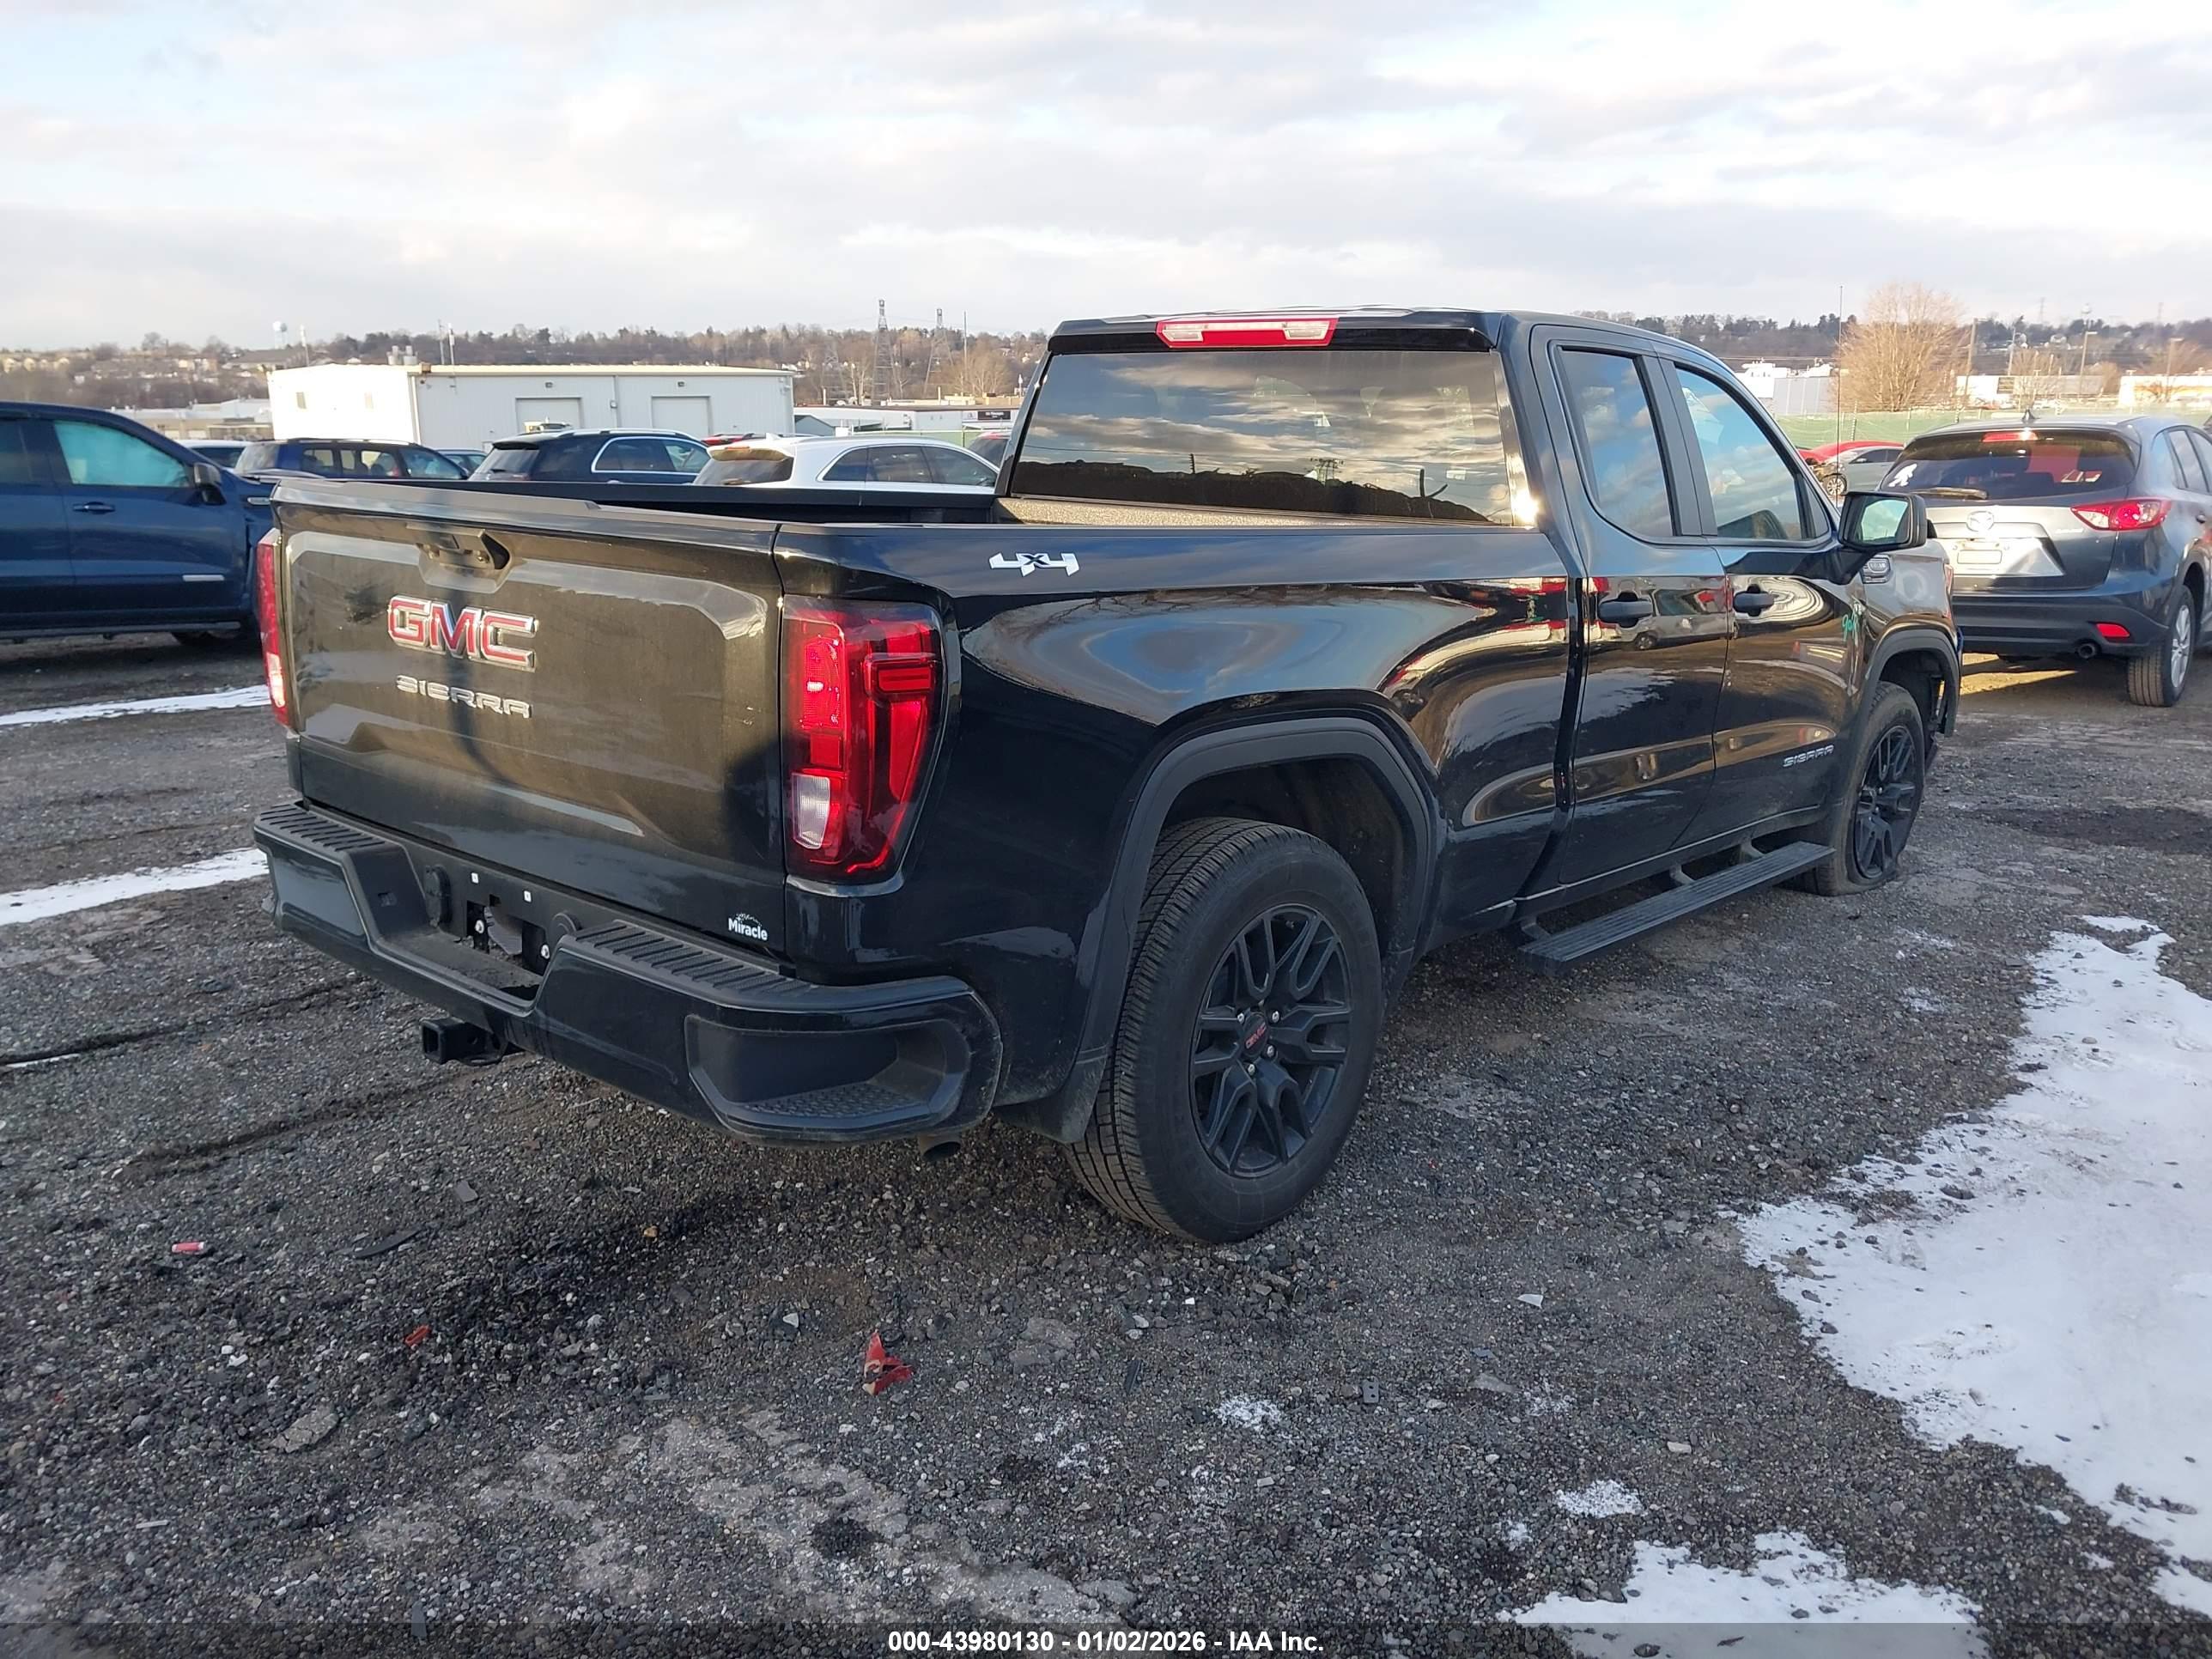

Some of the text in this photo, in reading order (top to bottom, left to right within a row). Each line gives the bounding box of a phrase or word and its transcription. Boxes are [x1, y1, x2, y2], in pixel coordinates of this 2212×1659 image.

[387, 593, 539, 672] GMC
[396, 674, 534, 719] SIERRA
[1783, 744, 1834, 768] SIERRA
[727, 917, 769, 941] Miracle
